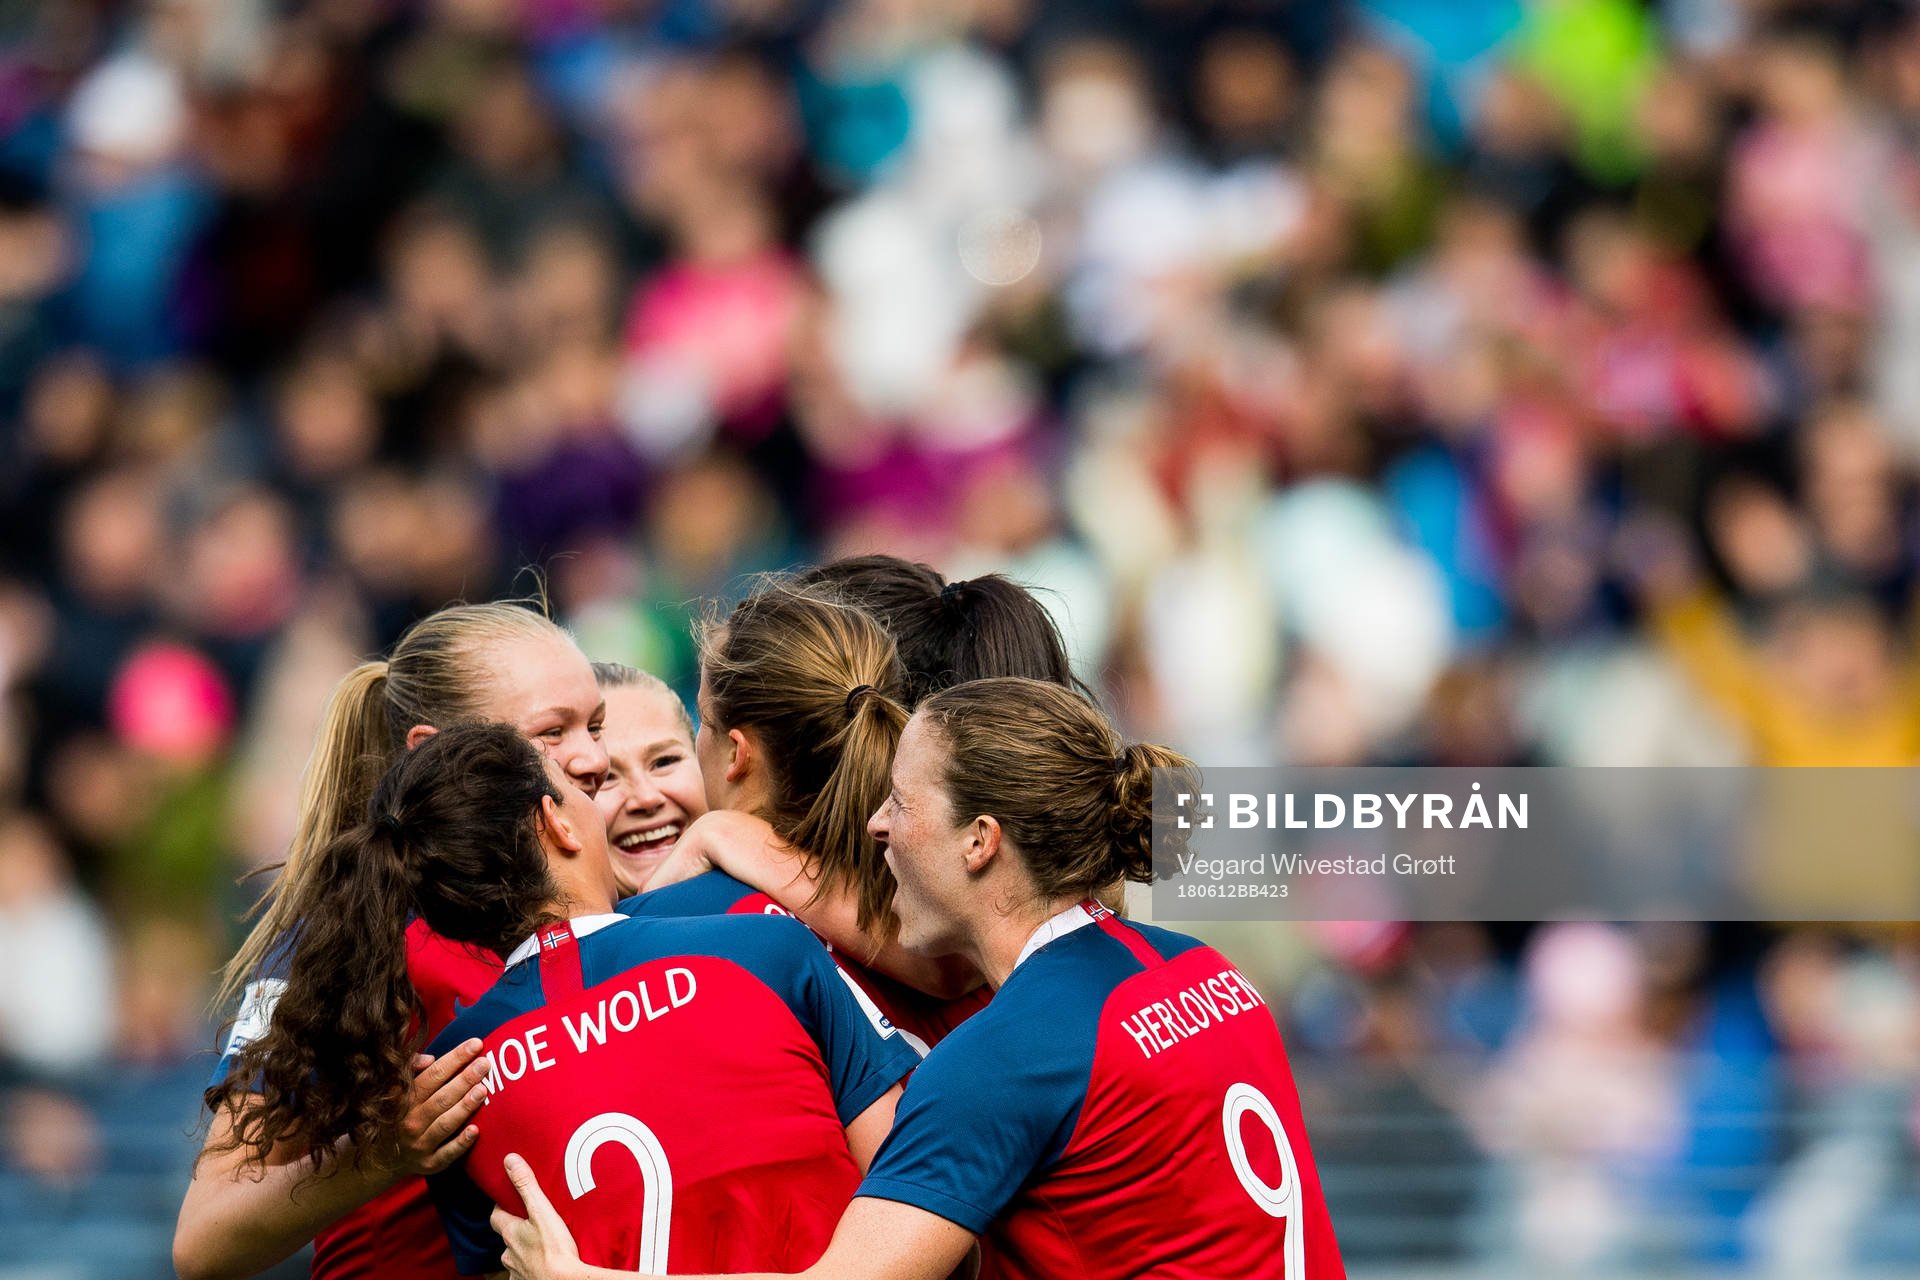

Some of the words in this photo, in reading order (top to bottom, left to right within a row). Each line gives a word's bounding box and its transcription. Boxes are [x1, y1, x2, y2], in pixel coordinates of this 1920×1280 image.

[561, 967, 697, 1054] WOLD
[1120, 969, 1266, 1060] HERLOVSEN
[1222, 1082, 1306, 1280] 9
